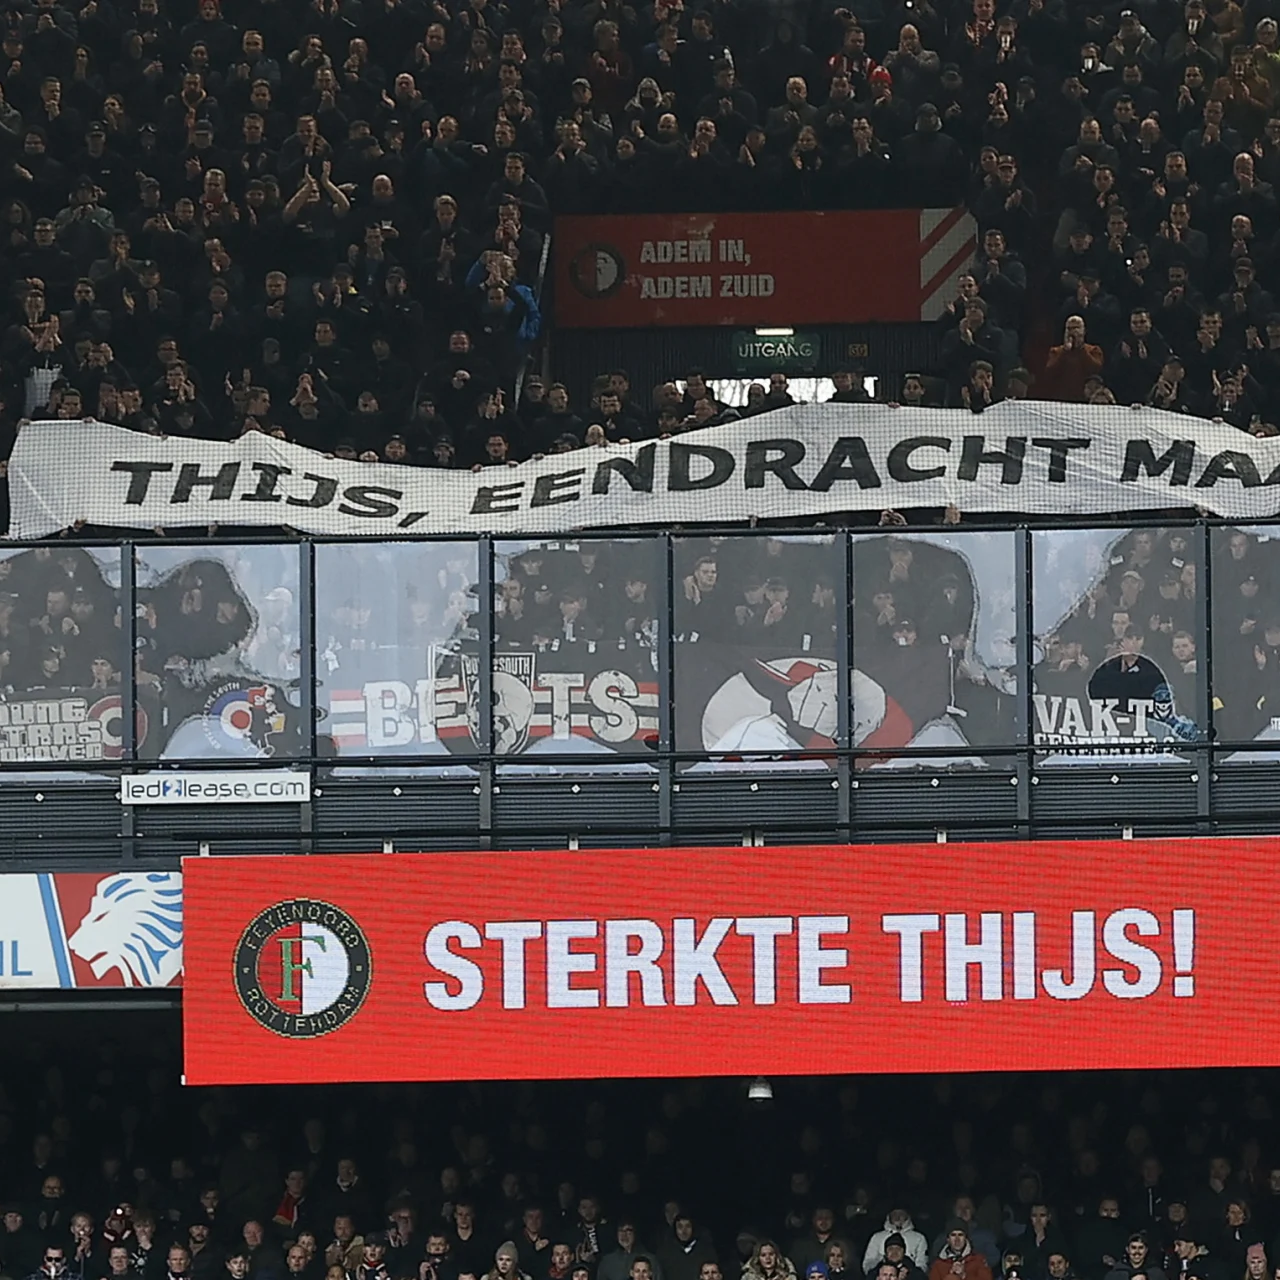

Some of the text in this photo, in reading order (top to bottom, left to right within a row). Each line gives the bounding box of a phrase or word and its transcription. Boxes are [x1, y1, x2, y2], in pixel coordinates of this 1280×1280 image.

[640, 239, 751, 267] ADEM IN,
[640, 273, 775, 299] ADEM ZUID
[738, 343, 813, 358] UITGANG
[110, 461, 428, 528] THIJS,
[468, 435, 1091, 515] EENDRACHT
[1033, 694, 1155, 738] VAK-T
[423, 907, 1195, 1010] STERKTE THIJS!
